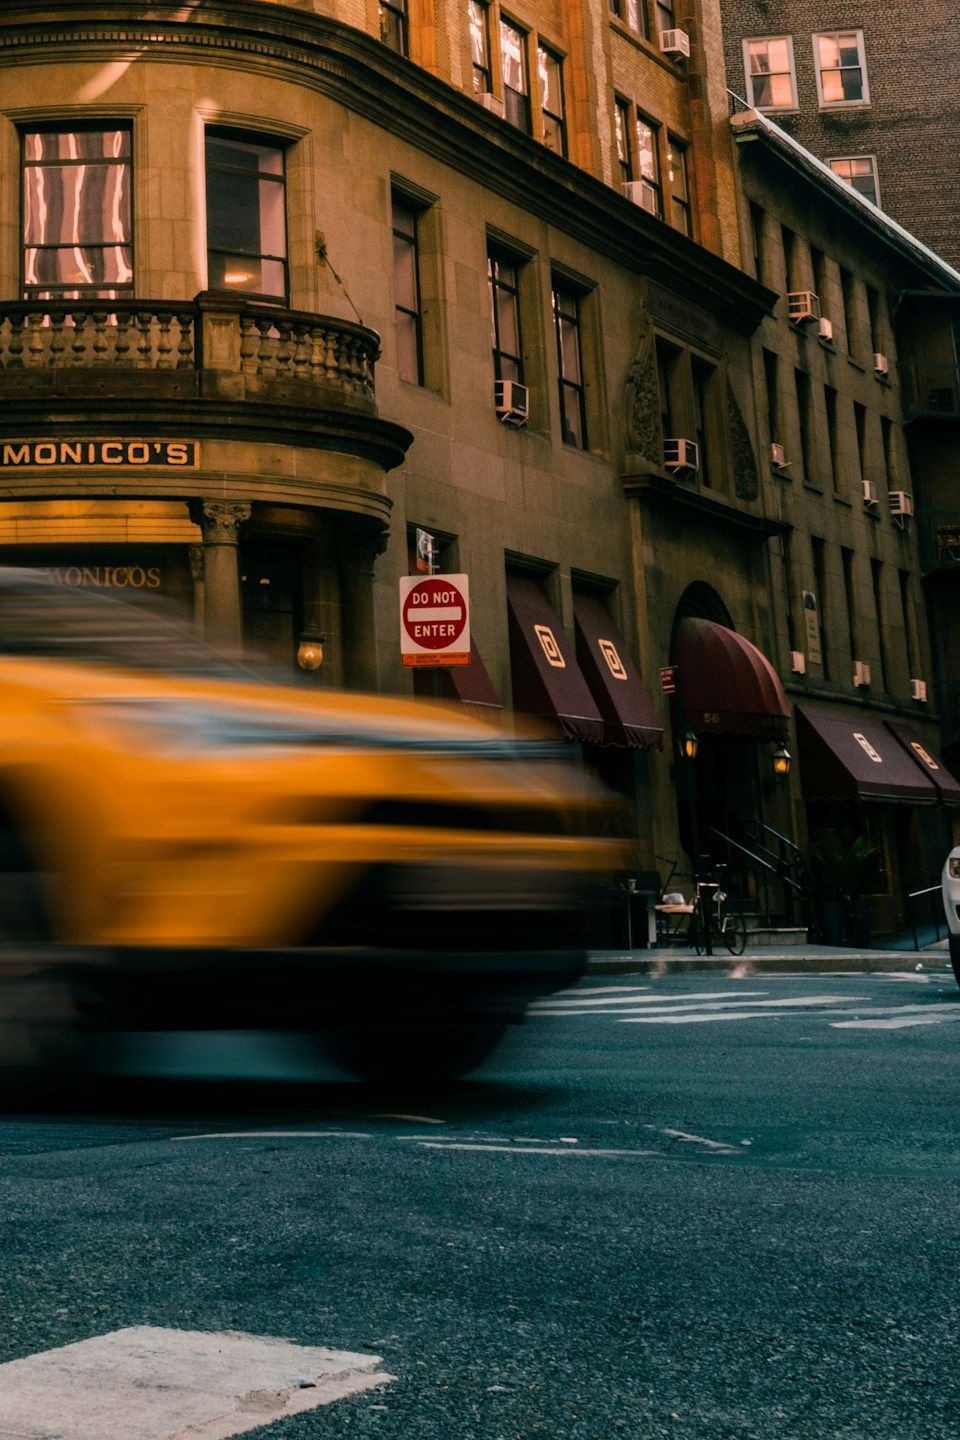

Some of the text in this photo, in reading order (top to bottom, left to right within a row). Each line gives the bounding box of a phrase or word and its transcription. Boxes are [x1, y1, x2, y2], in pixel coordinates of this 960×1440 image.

[412, 591, 457, 605] DO NOT
[414, 624, 456, 638] ENTER
[703, 712, 720, 724] 56
